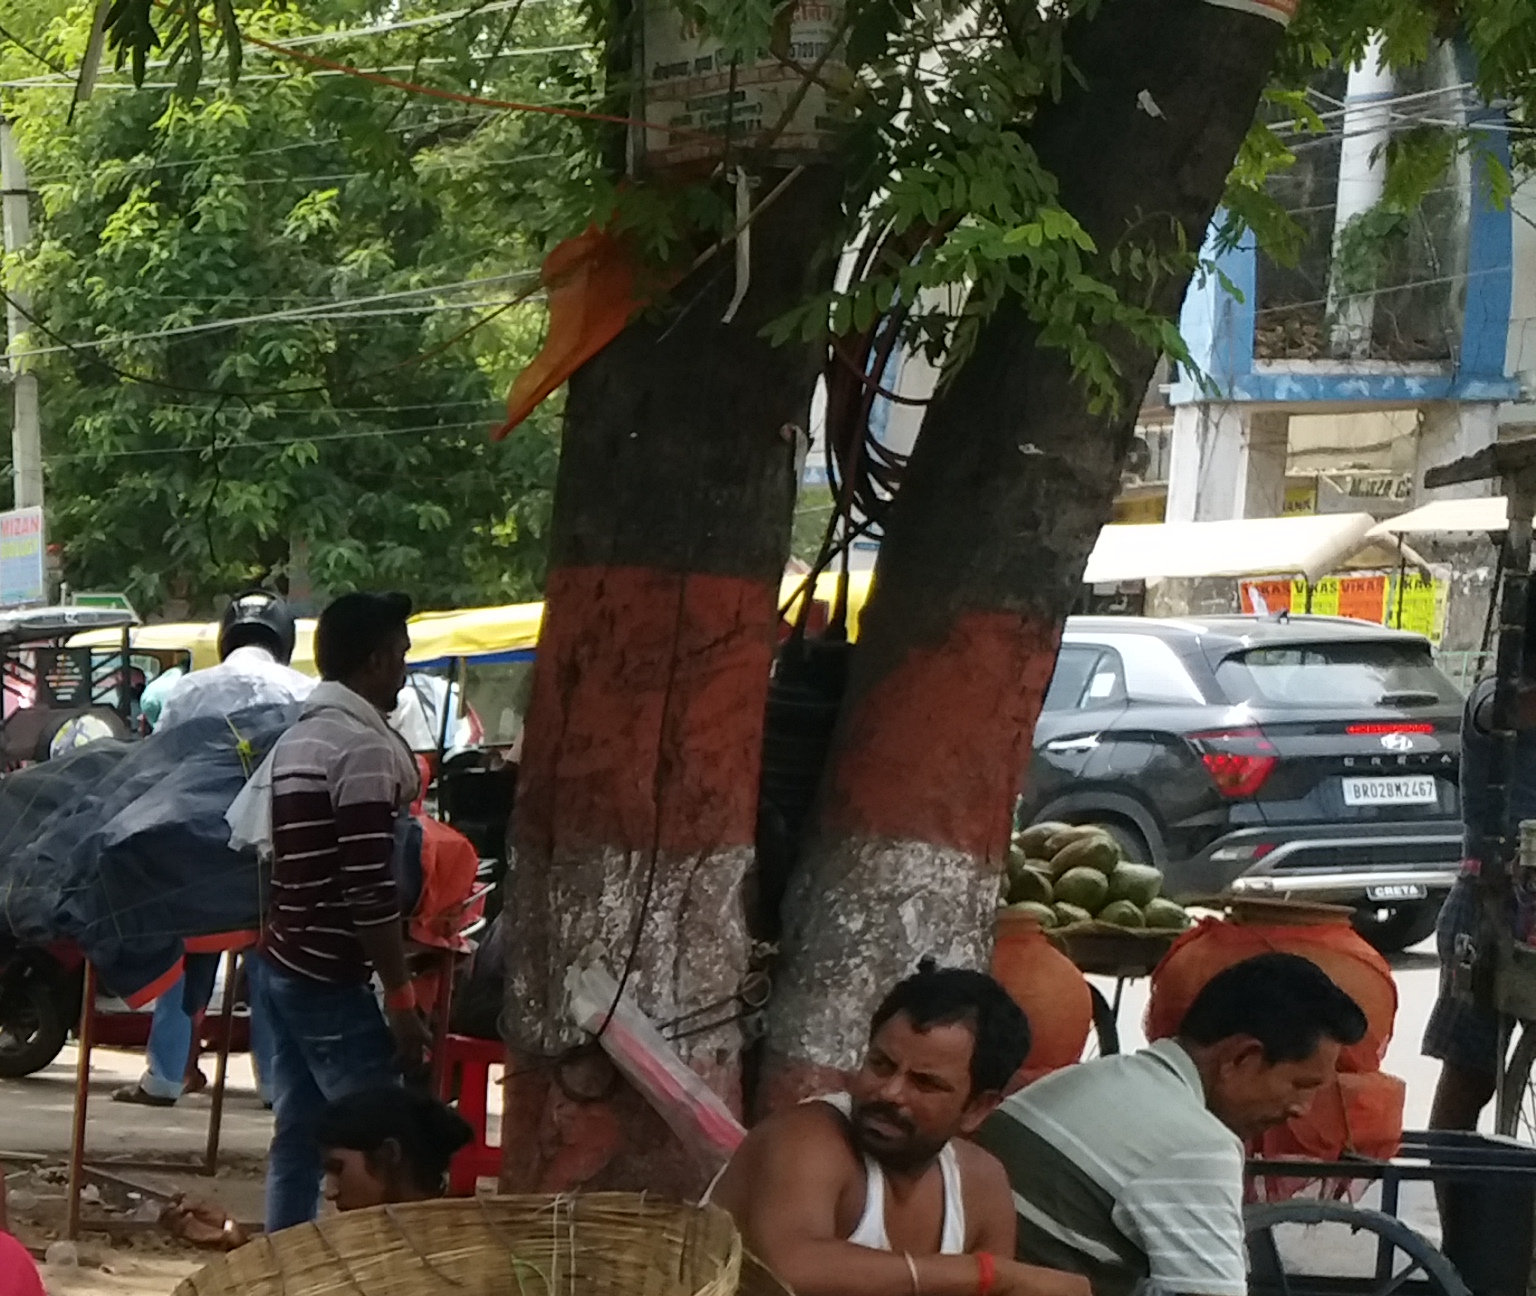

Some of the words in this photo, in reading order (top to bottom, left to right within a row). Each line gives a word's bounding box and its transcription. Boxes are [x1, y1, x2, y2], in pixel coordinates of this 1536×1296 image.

[1243, 581, 1291, 595] VKAS
[1295, 580, 1338, 595] VKAS
[1343, 753, 1452, 768] CRETA
[1353, 781, 1433, 800] BR02BM2467
[1374, 884, 1419, 898] CRETA
